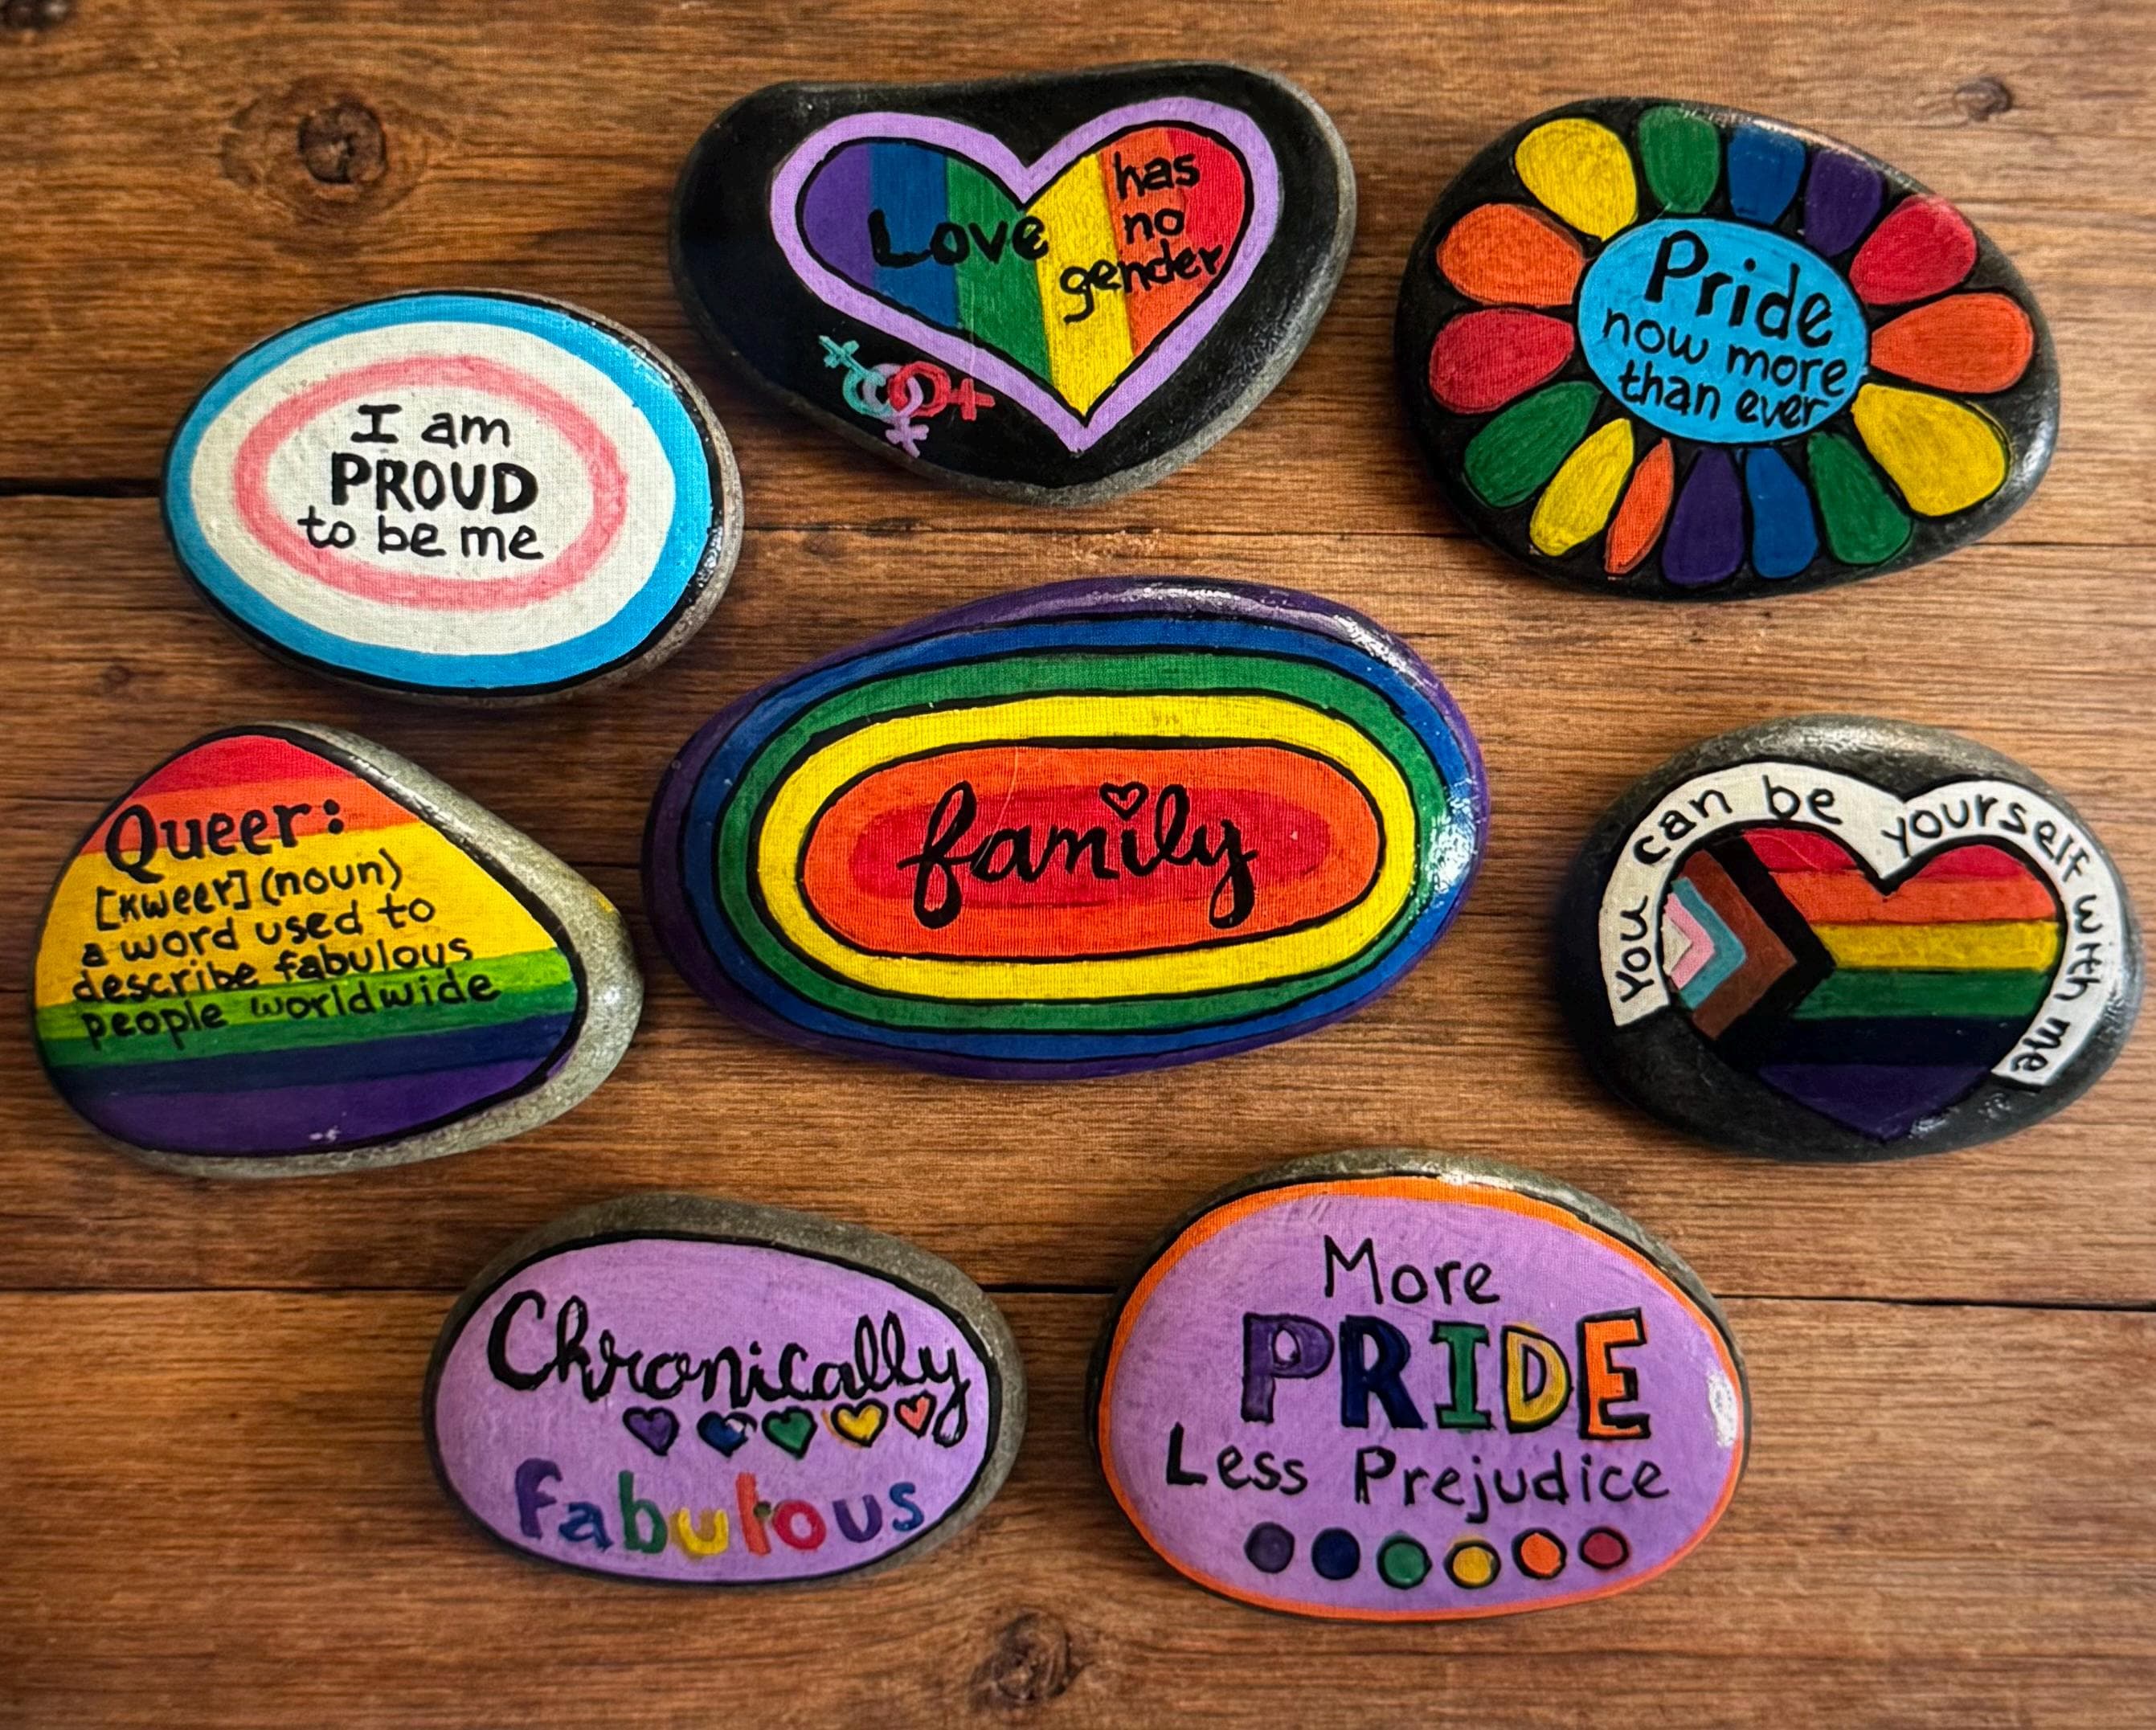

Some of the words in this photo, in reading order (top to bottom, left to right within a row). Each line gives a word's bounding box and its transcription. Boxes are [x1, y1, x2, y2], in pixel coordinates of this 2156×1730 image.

[868, 210, 1048, 268] Love
[1115, 152, 1201, 198] has
[1125, 208, 1184, 240] no
[1059, 239, 1223, 325] gender
[1644, 230, 1832, 348] Pride
[1603, 309, 1708, 362] now
[1728, 343, 1847, 397] more
[350, 404, 402, 443] I
[421, 412, 510, 449] am
[1618, 359, 1720, 420] than
[1735, 388, 1829, 429] ever
[331, 452, 538, 514] PROUD
[297, 505, 357, 549] to
[378, 514, 447, 557] be
[460, 525, 544, 562] me
[1633, 787, 1733, 865] can
[1762, 775, 1843, 823] be
[105, 800, 346, 882] Queer:
[260, 849, 403, 906] (noun)
[897, 779, 1258, 930] family
[80, 943, 108, 967] a
[121, 918, 237, 960] word
[255, 900, 364, 944] used
[378, 893, 436, 929] to
[2048, 894, 2103, 1001] with
[73, 960, 260, 1004] describe
[275, 936, 476, 981] fabulous
[81, 1001, 228, 1050] people
[251, 970, 501, 1020] worldwide
[2010, 1016, 2071, 1074] me
[1323, 1234, 1501, 1306] More
[487, 1290, 971, 1447] Chronically
[1241, 1307, 1651, 1441] PRIDE
[1166, 1422, 1309, 1495] Less
[1355, 1446, 1670, 1523] Prejudice
